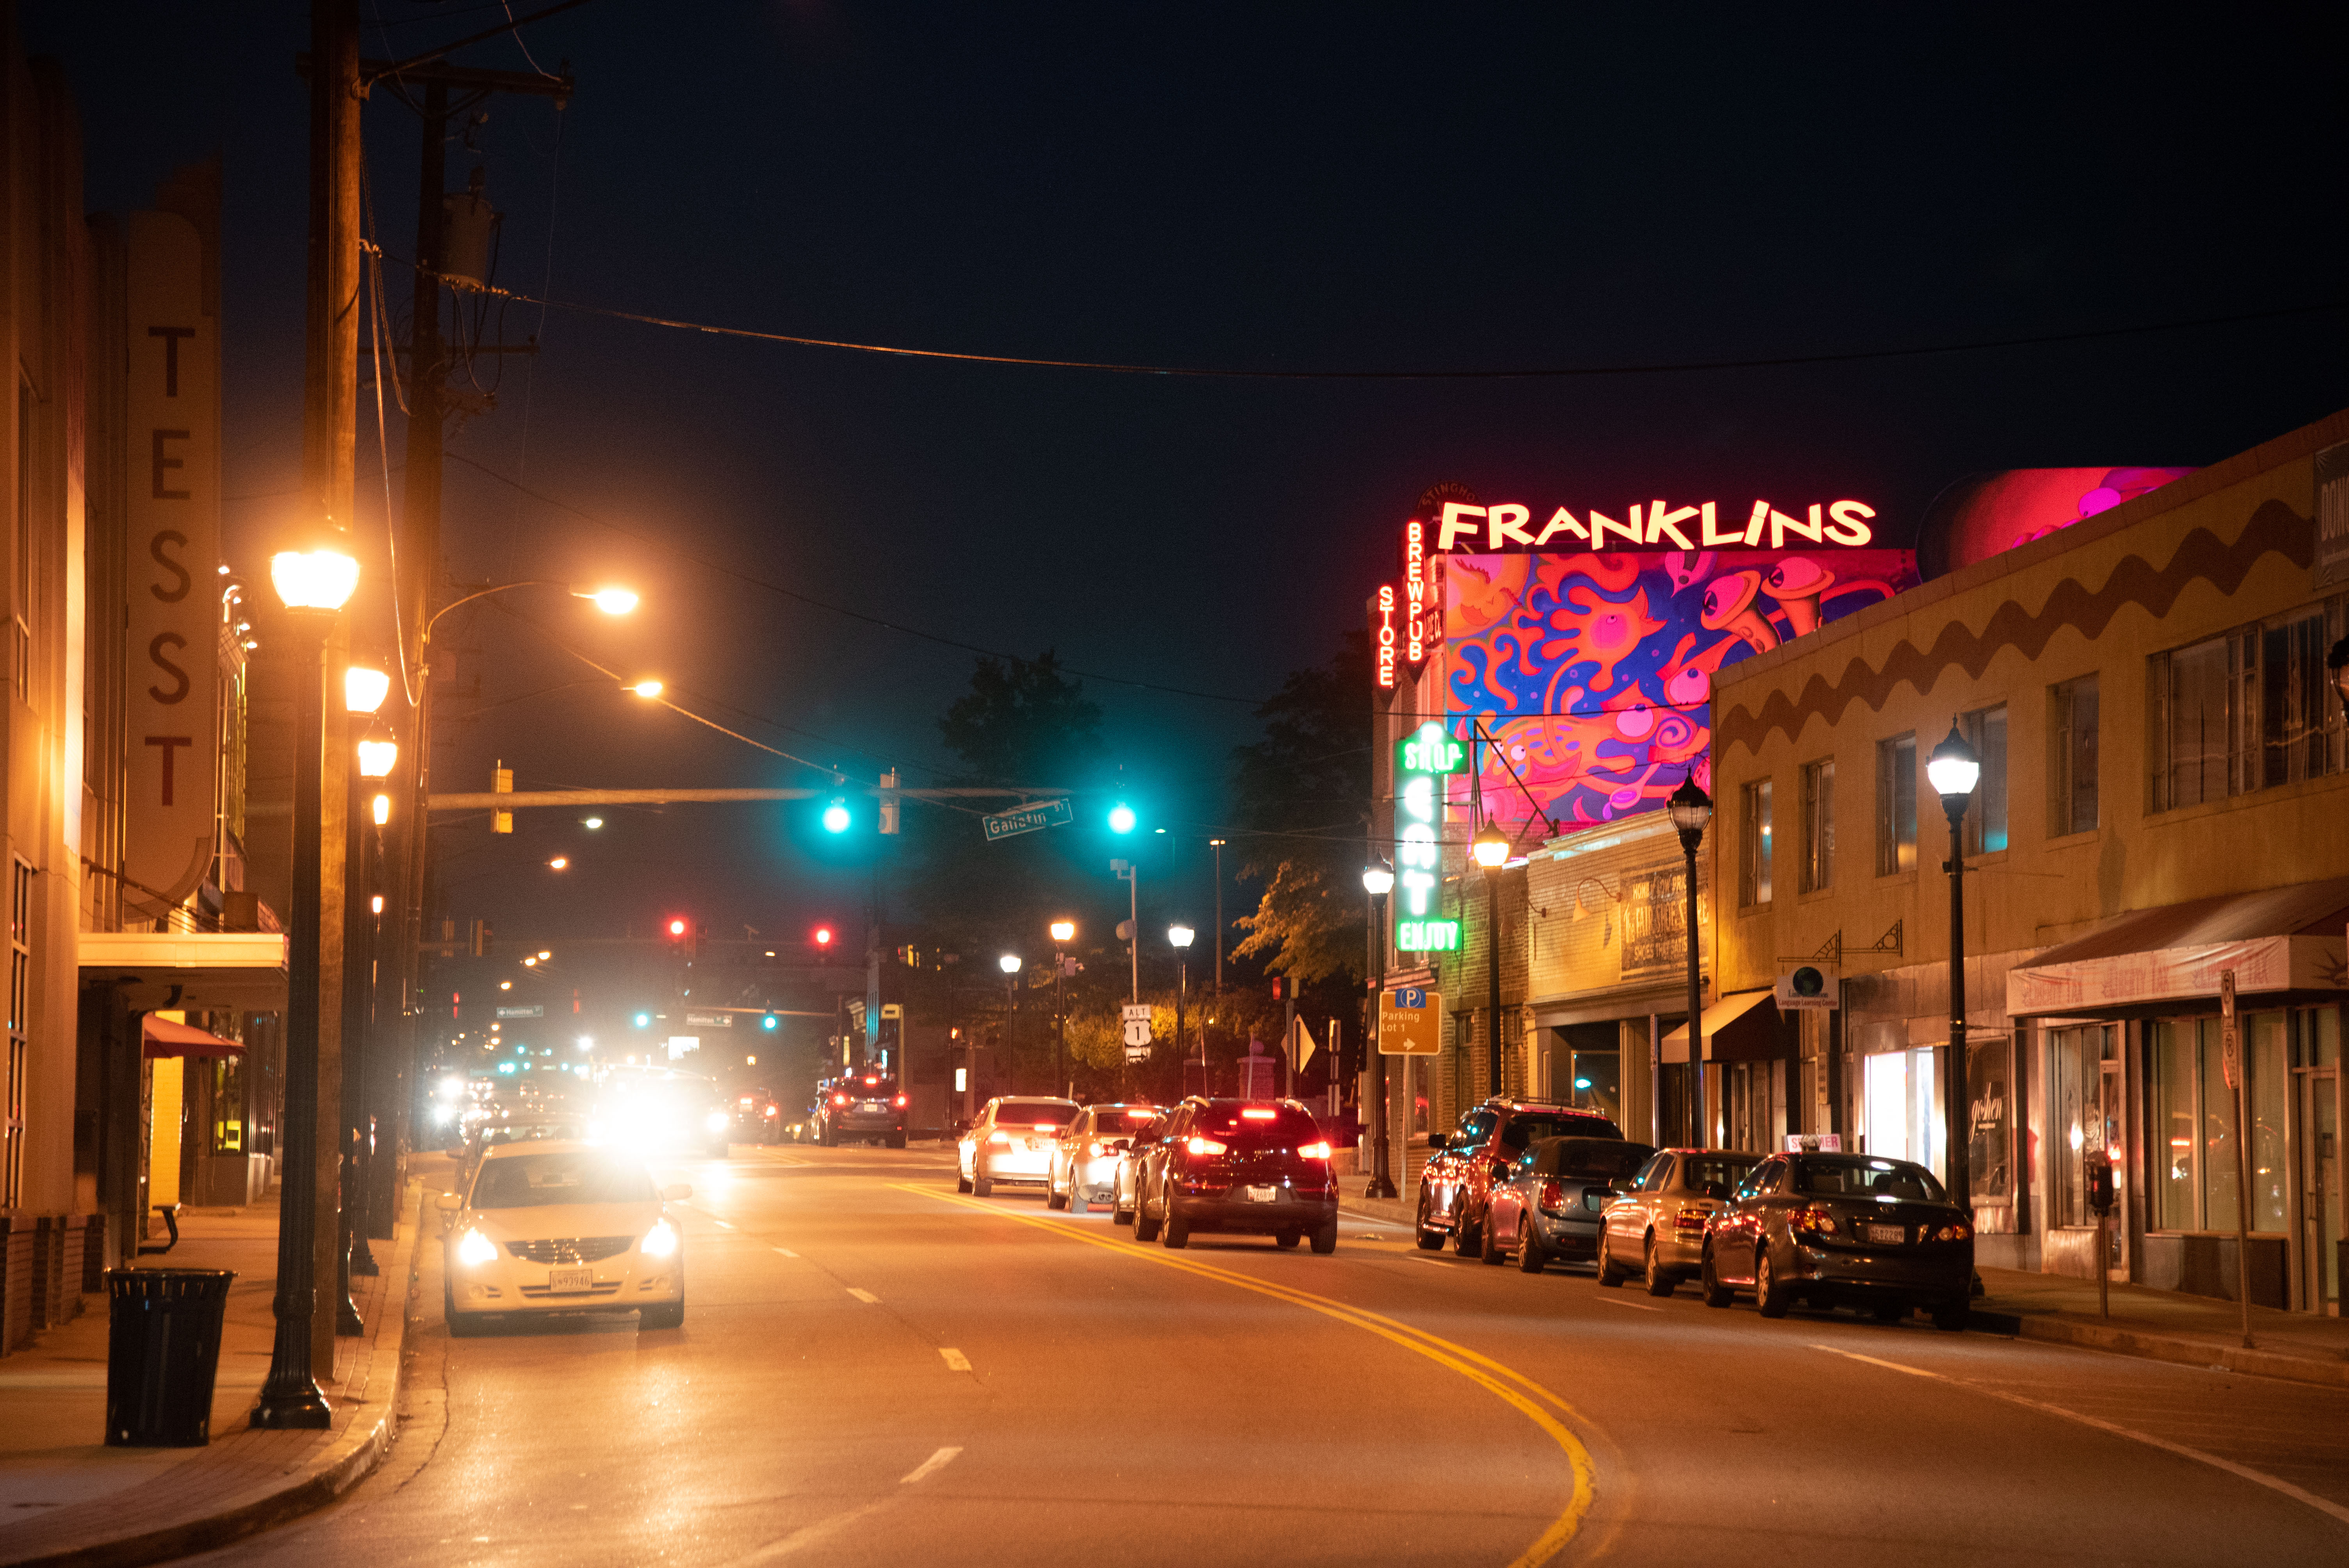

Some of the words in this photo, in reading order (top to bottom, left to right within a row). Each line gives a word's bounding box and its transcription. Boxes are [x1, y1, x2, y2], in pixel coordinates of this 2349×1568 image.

[1438, 500, 1876, 550] FRANKLINS
[144, 326, 195, 807] TESST
[1407, 522, 1424, 661] BREWPUB
[1379, 586, 1395, 686] STORE
[1404, 743, 1463, 771] SHOP
[990, 812, 1046, 834] Gallatin
[1400, 921, 1458, 950] ENJOY
[1129, 1008, 1146, 1016] ALT
[1382, 1011, 1420, 1023] Parking
[1135, 1026, 1140, 1041] 1
[1382, 1023, 1397, 1032] Lot
[1401, 1023, 1405, 1032] 1
[1968, 1082, 2002, 1145] goshen
[1791, 1136, 1838, 1149] SMER
